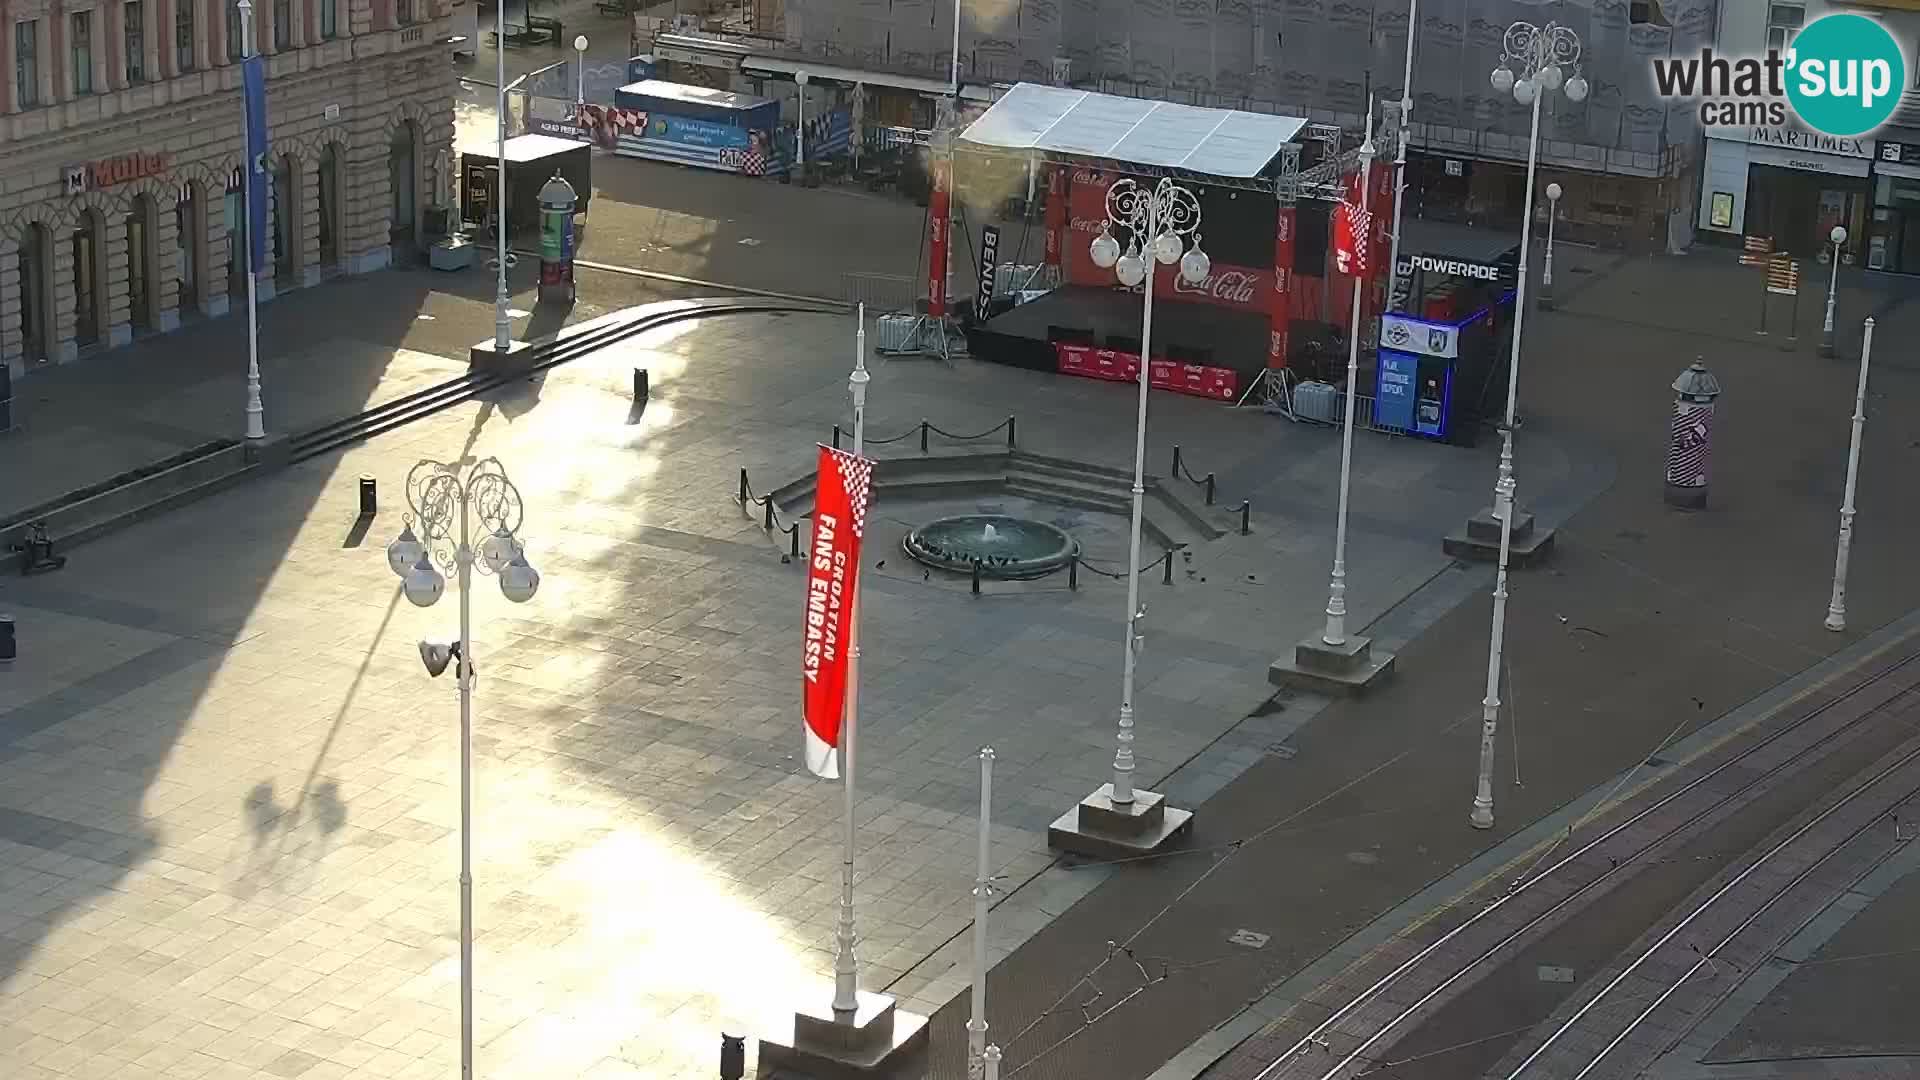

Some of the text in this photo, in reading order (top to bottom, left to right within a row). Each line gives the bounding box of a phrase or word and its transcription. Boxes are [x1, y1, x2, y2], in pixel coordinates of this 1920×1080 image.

[1753, 127, 1865, 154] MARTIMEX
[1411, 255, 1499, 281] POWERADE
[804, 513, 837, 683] FANS EMBASSY
[824, 551, 846, 662] CROATIAN
